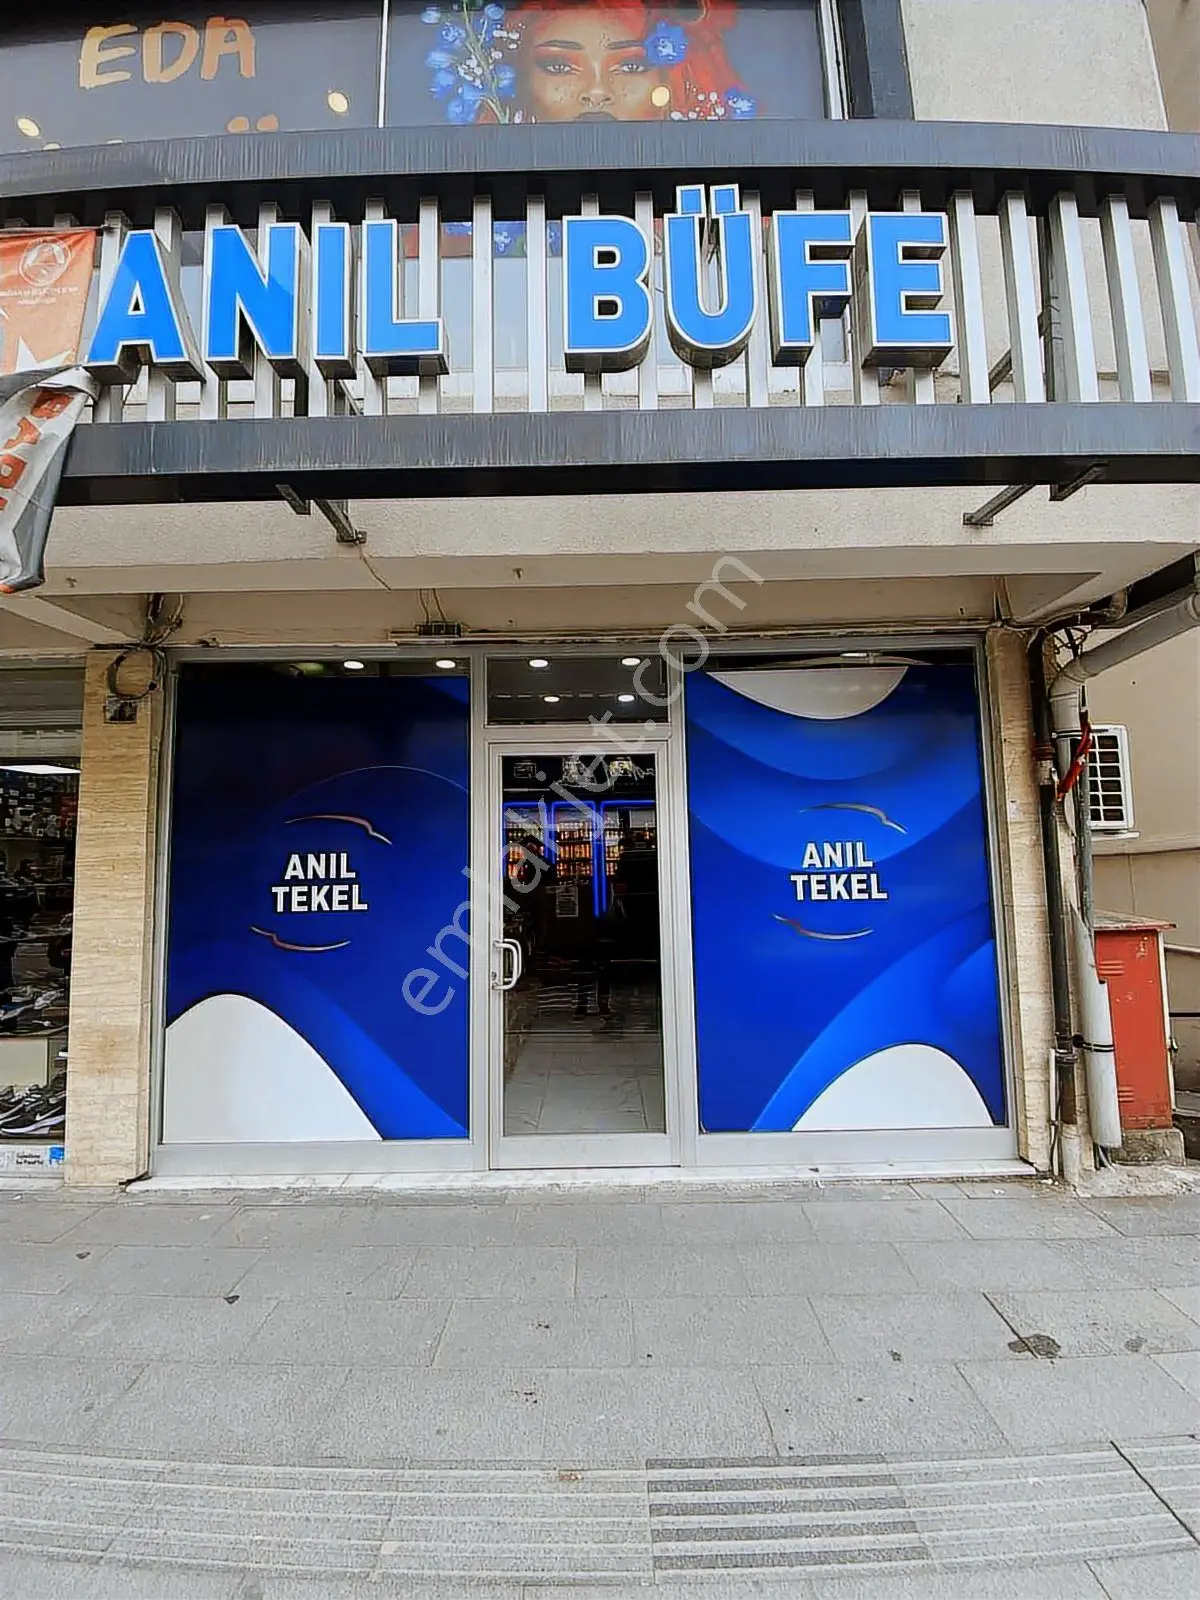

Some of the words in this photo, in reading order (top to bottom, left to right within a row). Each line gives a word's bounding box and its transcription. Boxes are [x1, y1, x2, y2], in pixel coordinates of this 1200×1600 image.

[79, 16, 256, 90] EDA
[83, 218, 446, 366] ANIL
[562, 183, 956, 353] BÜFE
[284, 852, 356, 880] ANIL
[801, 841, 873, 869] ANIL
[271, 884, 368, 913] TEKEL
[790, 873, 888, 901] TEKEL
